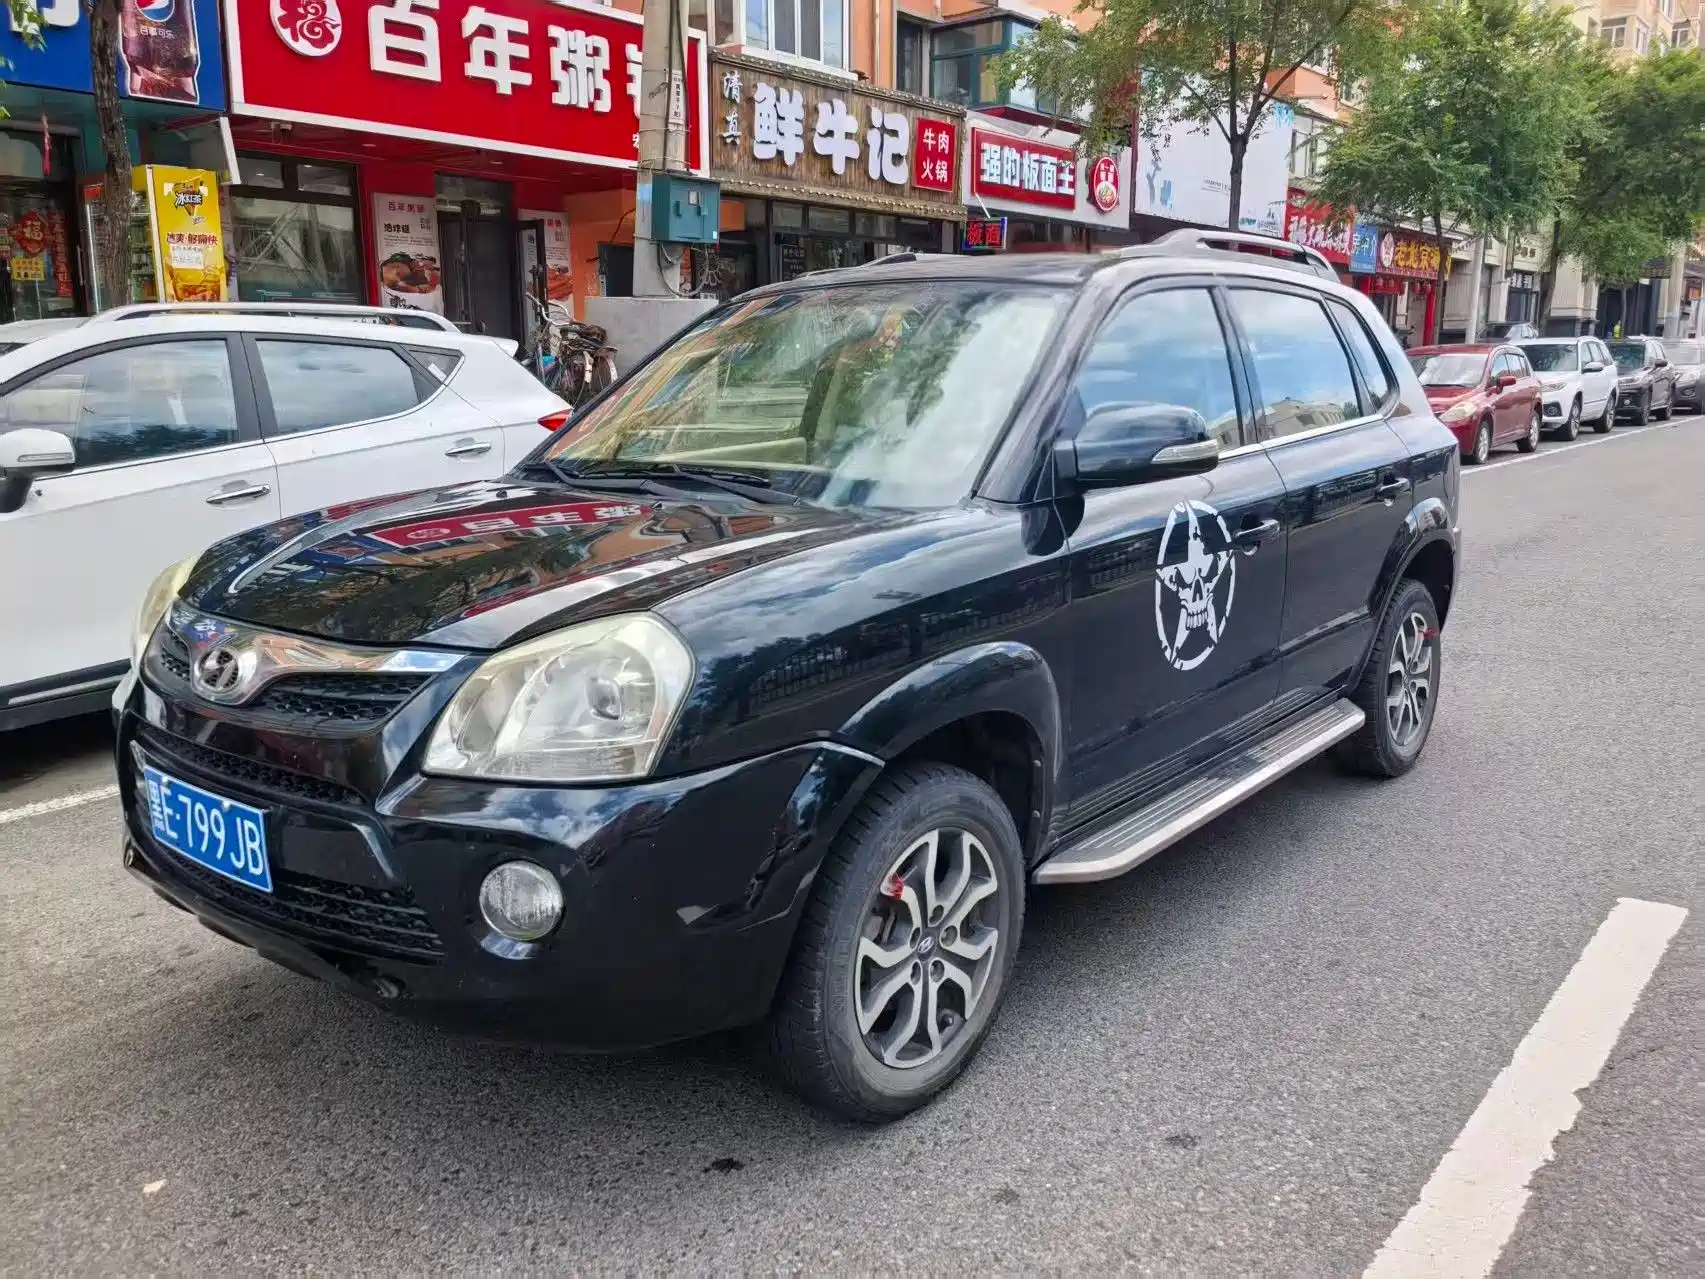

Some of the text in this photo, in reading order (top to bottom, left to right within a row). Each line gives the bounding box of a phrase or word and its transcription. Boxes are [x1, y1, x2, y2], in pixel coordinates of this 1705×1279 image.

[723, 70, 742, 146] 清真
[753, 82, 909, 185] 鲜牛记
[923, 127, 950, 155] 牛肉
[920, 159, 949, 184] 火锅
[980, 142, 1075, 195] 强的板面王
